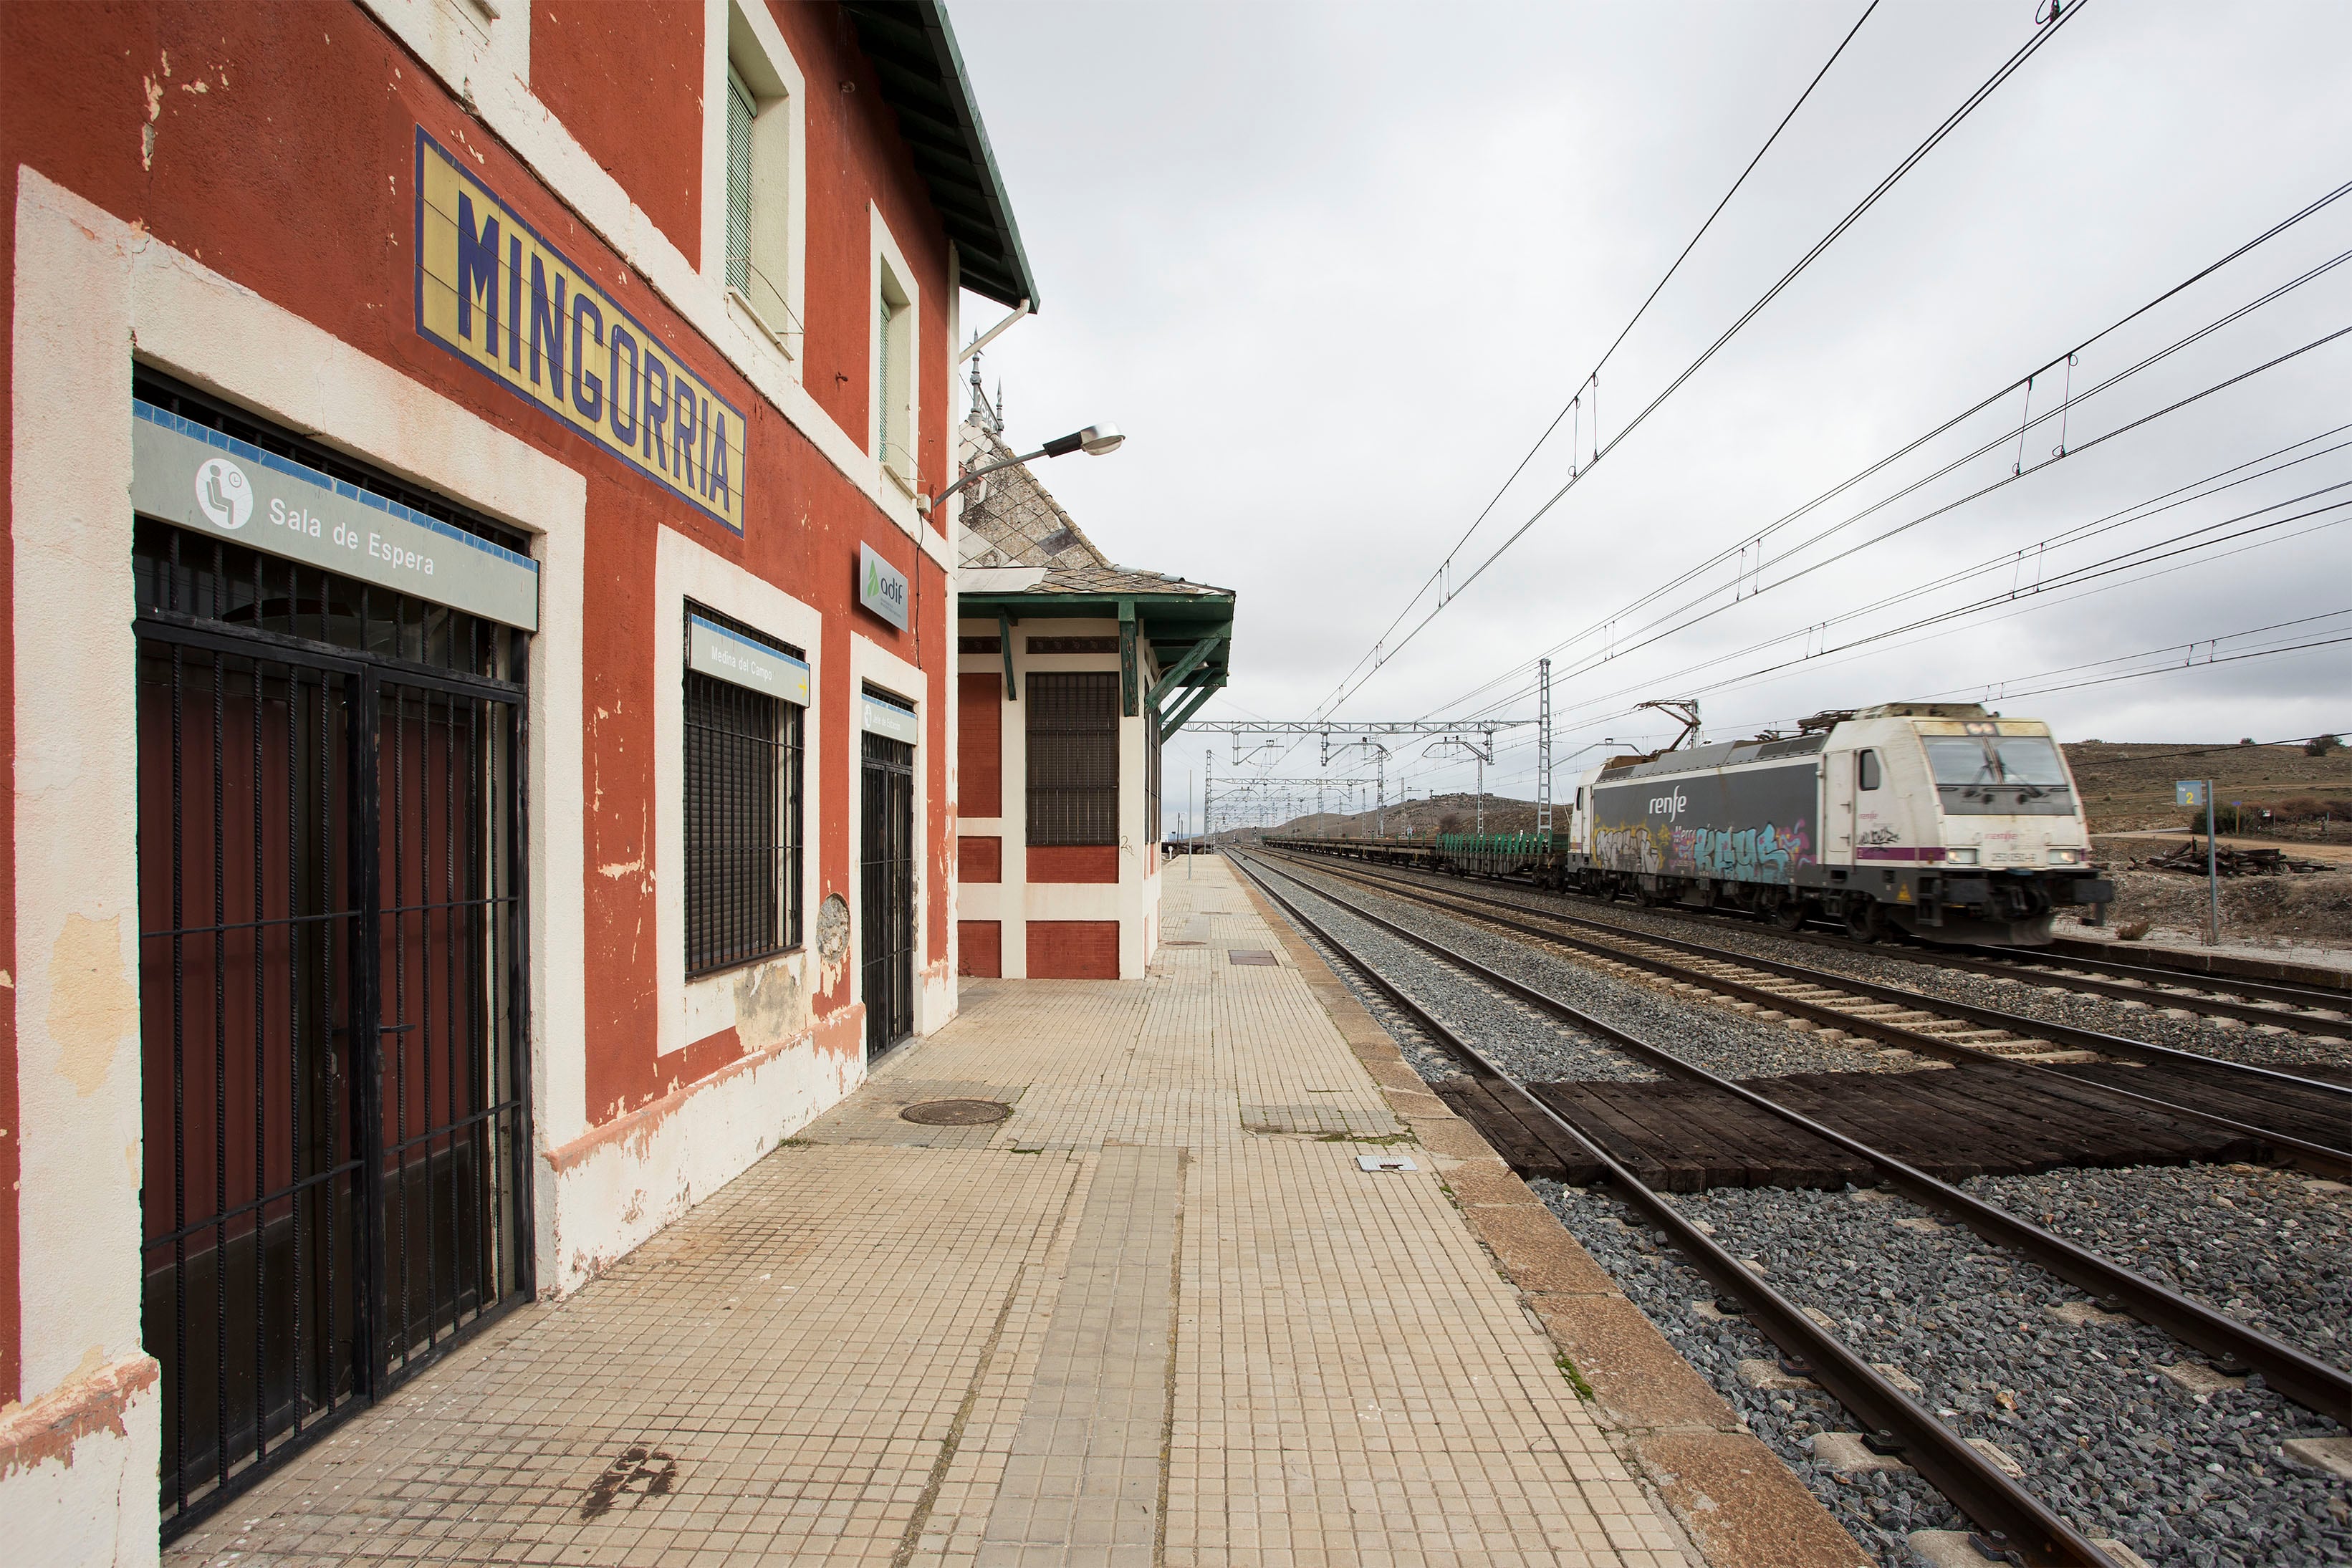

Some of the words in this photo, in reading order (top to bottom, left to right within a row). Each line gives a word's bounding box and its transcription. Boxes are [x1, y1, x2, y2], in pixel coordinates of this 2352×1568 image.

[458, 189, 730, 514] MINGORRIA
[269, 498, 321, 537] Sala
[333, 522, 358, 549] de
[369, 532, 434, 575] Espera
[880, 577, 903, 605] adif
[711, 645, 736, 668] Medina
[739, 657, 749, 672] del
[751, 661, 772, 682] Campo
[1648, 784, 1687, 823] renfe
[2186, 792, 2194, 804] 2
